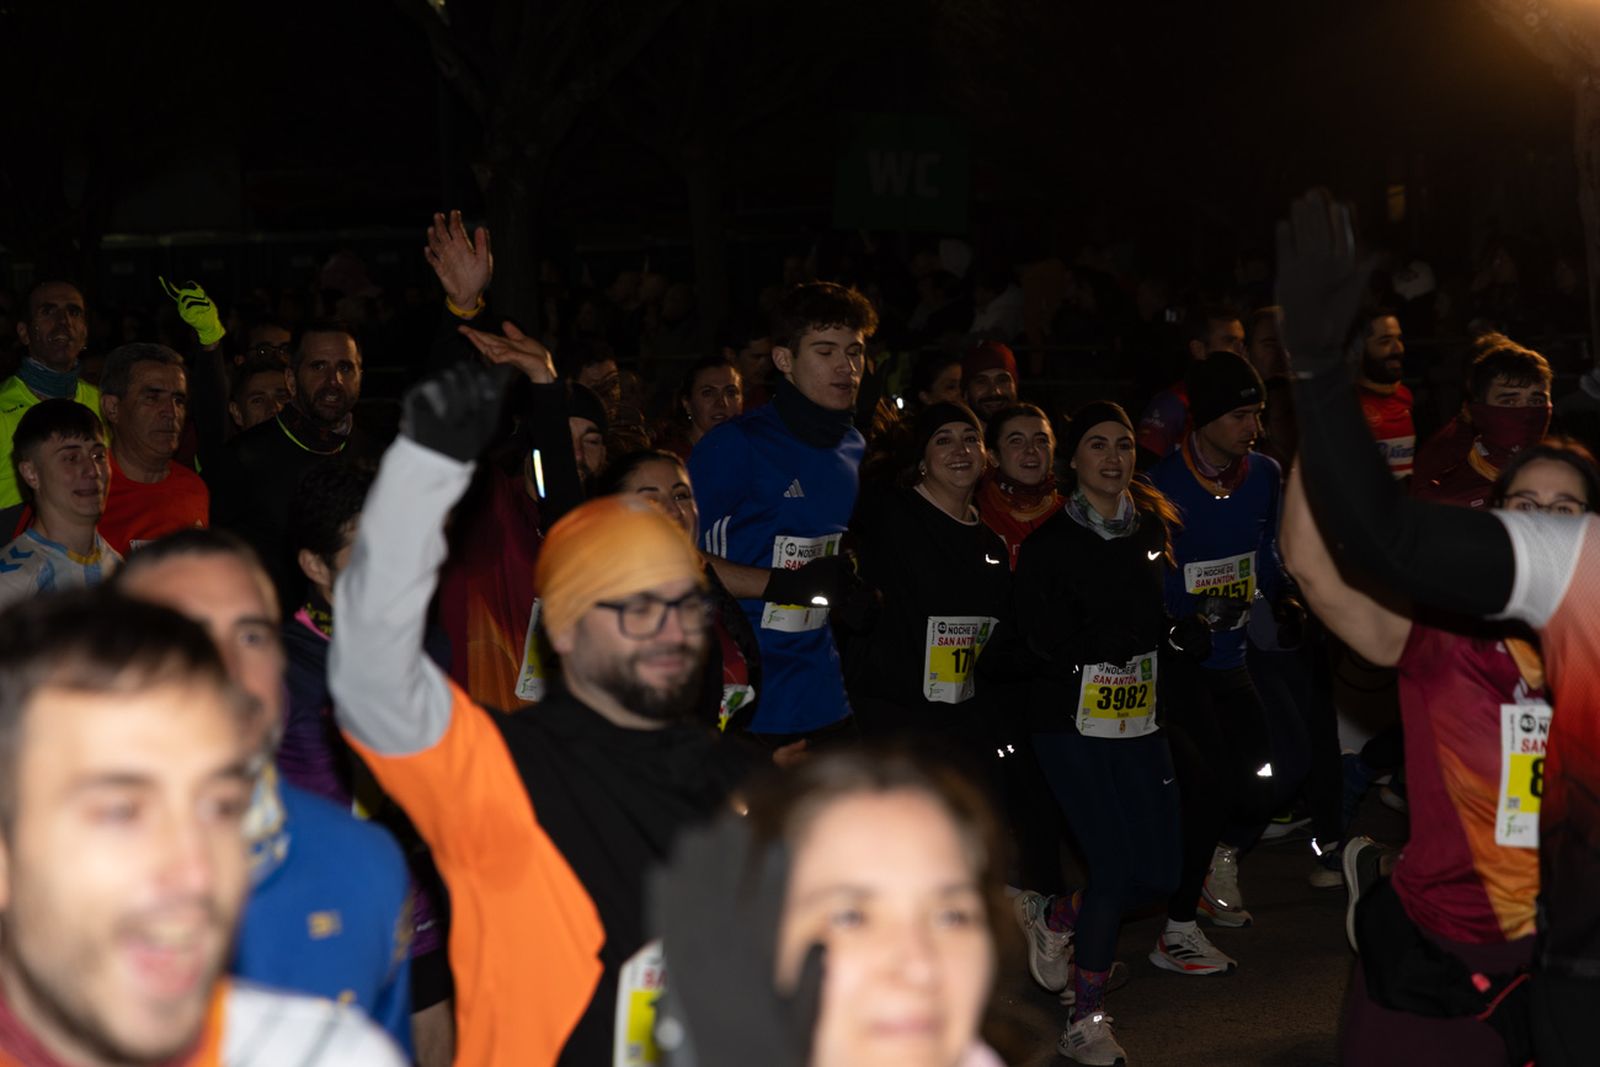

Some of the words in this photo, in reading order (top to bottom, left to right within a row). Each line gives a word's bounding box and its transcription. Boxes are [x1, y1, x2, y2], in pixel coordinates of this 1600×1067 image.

[868, 151, 942, 198] WC
[1204, 567, 1226, 577] NOCHE
[1195, 579, 1211, 588] SAN
[948, 626, 970, 635] NOCHE
[938, 637, 955, 646] SAN
[1093, 675, 1112, 684] SAN
[1097, 684, 1147, 710] 3982
